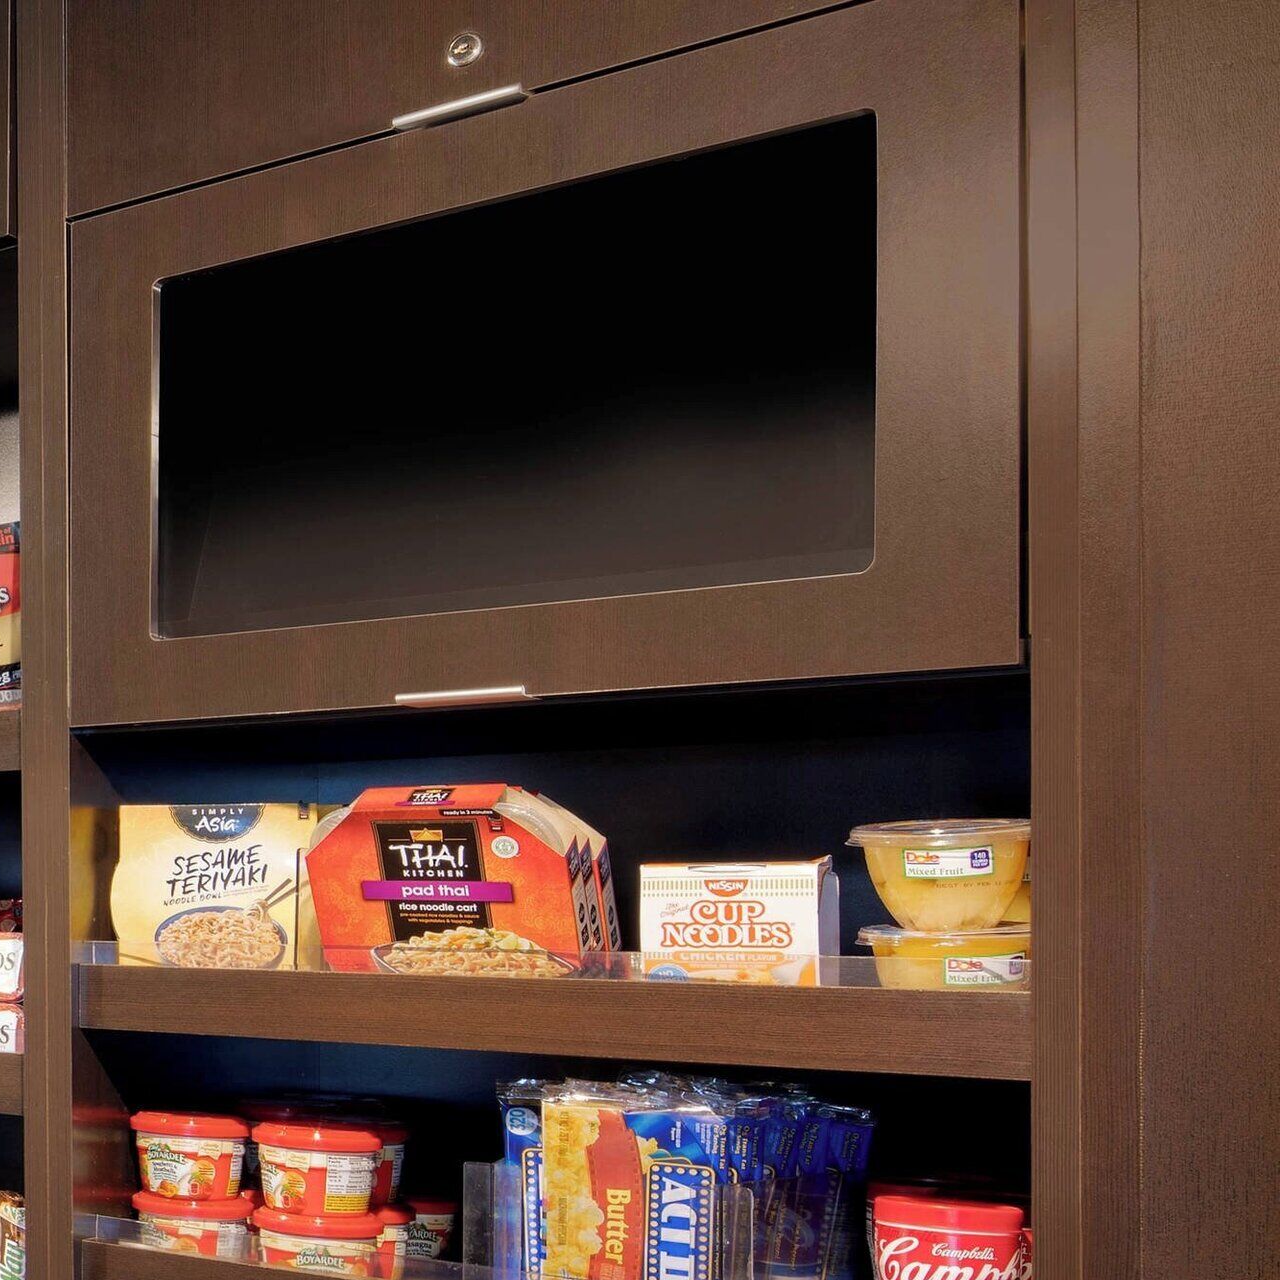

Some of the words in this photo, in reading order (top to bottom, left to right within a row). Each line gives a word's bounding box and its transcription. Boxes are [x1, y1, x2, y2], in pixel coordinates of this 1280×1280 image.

[191, 807, 244, 817] SIMPLY
[194, 815, 237, 833] Asia
[172, 844, 263, 877] SESAME
[388, 843, 465, 869] THAI
[905, 851, 940, 865] Dole
[973, 851, 987, 861] 140
[403, 869, 464, 878] KITCHEN
[907, 867, 936, 877] Mixed
[939, 866, 965, 876] Fruit
[166, 863, 268, 898] TERIYAKI
[708, 880, 745, 892] NISSIN
[402, 885, 435, 898] pad
[438, 884, 470, 897] thai
[163, 894, 196, 907] NOODLE
[199, 891, 223, 903] BOWL
[399, 902, 417, 911] rice
[420, 902, 454, 911] noodle
[456, 903, 478, 912] cart
[690, 900, 766, 925] CUP
[660, 922, 793, 949] NOODLES
[947, 958, 983, 971] Dole
[948, 974, 978, 984] Mixed
[509, 1109, 527, 1131] 320
[147, 1151, 187, 1165] BOYARDEE
[661, 1175, 698, 1250] ACT
[605, 1188, 632, 1265] Butter
[931, 1242, 997, 1261] Campbell's
[296, 1254, 345, 1269] BOYARDEE
